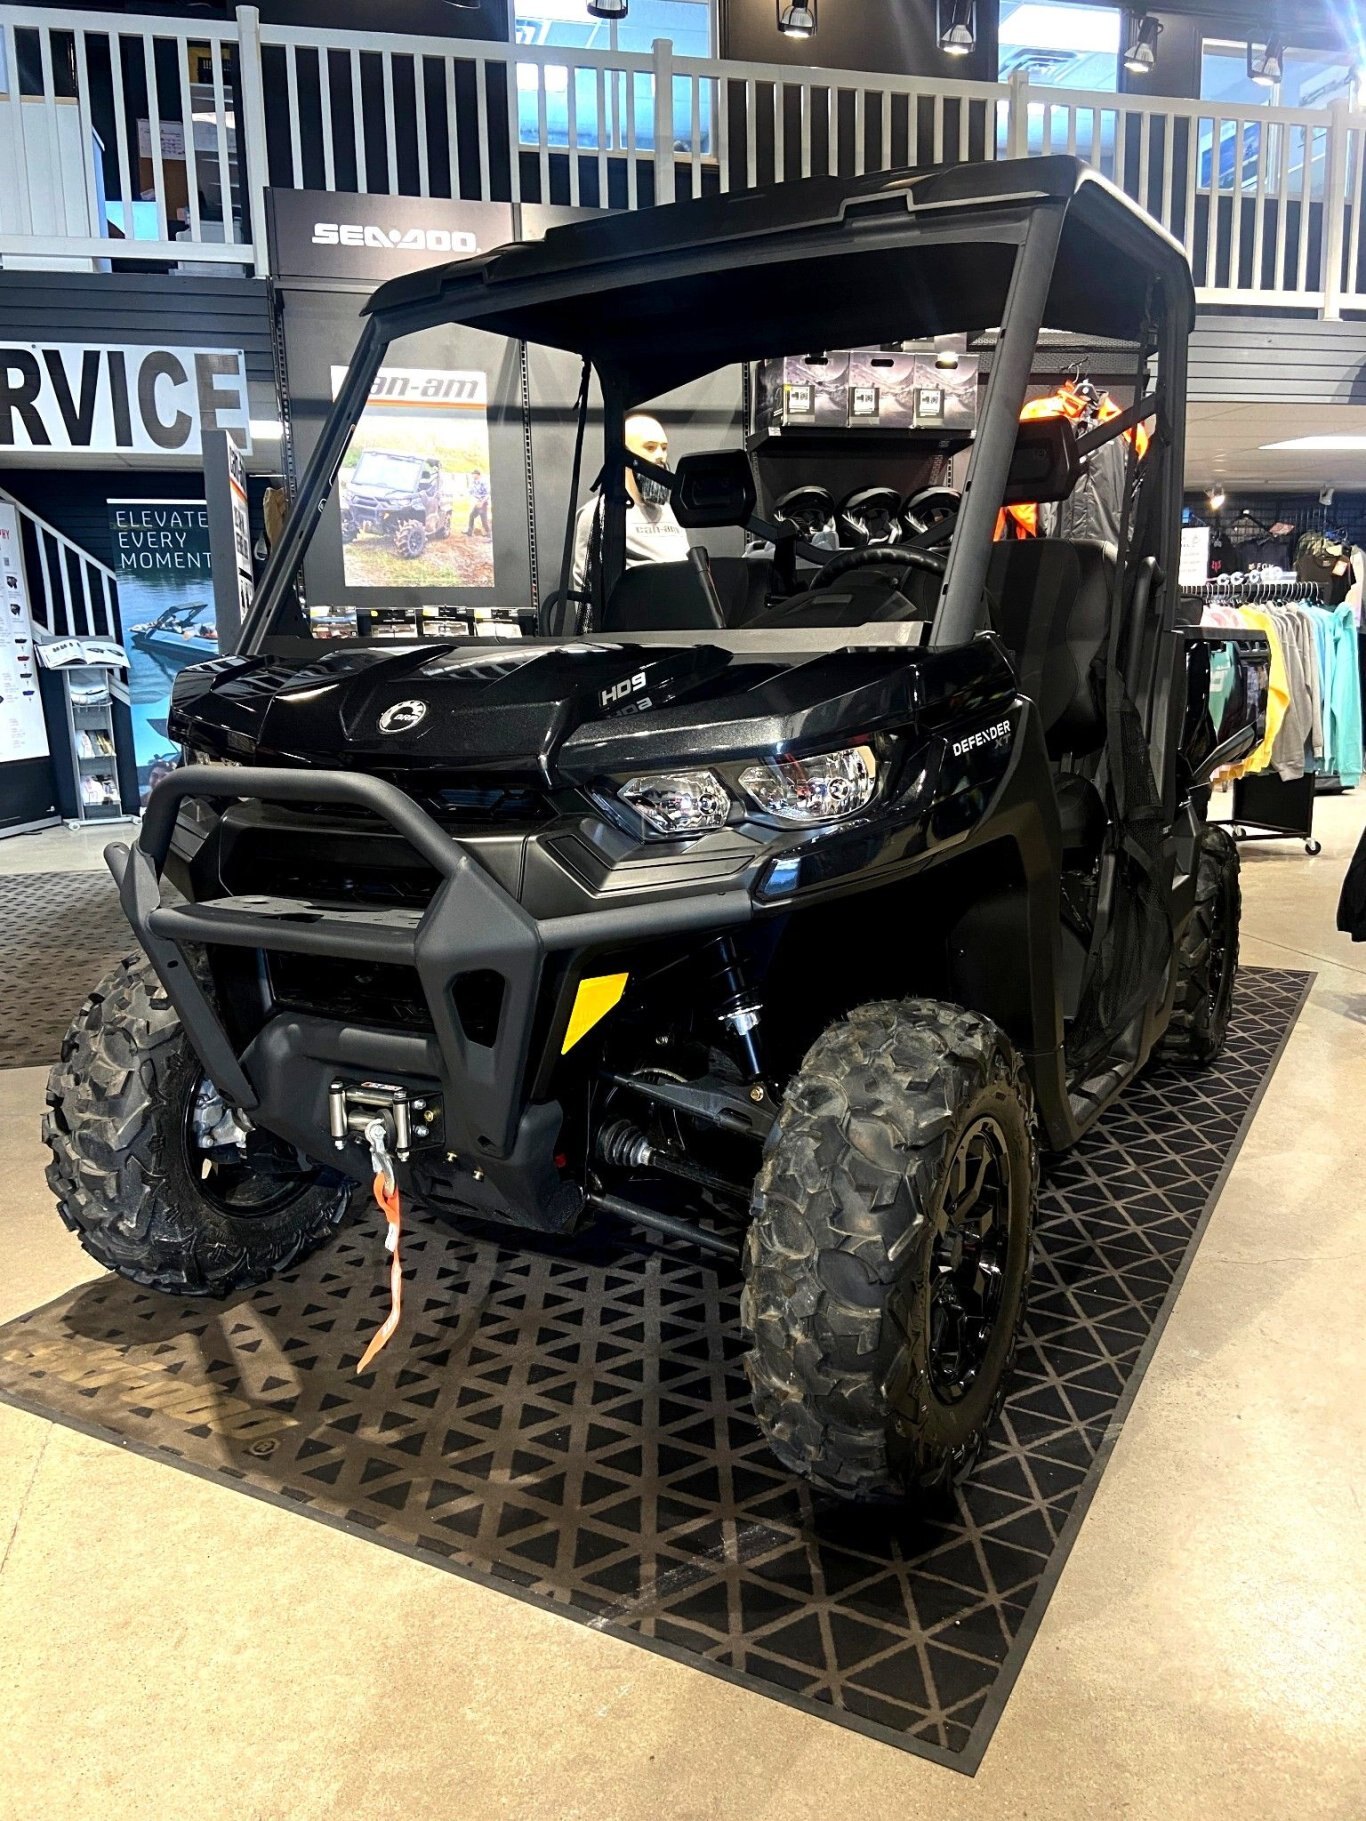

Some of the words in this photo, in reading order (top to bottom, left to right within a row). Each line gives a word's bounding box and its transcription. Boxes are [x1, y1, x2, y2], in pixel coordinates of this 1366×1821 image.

[369, 376, 479, 399] an-am
[115, 510, 208, 528] ELEVATE
[118, 531, 186, 549] EVERY
[602, 671, 647, 706] HD9
[952, 720, 1011, 757] DEFENDER
